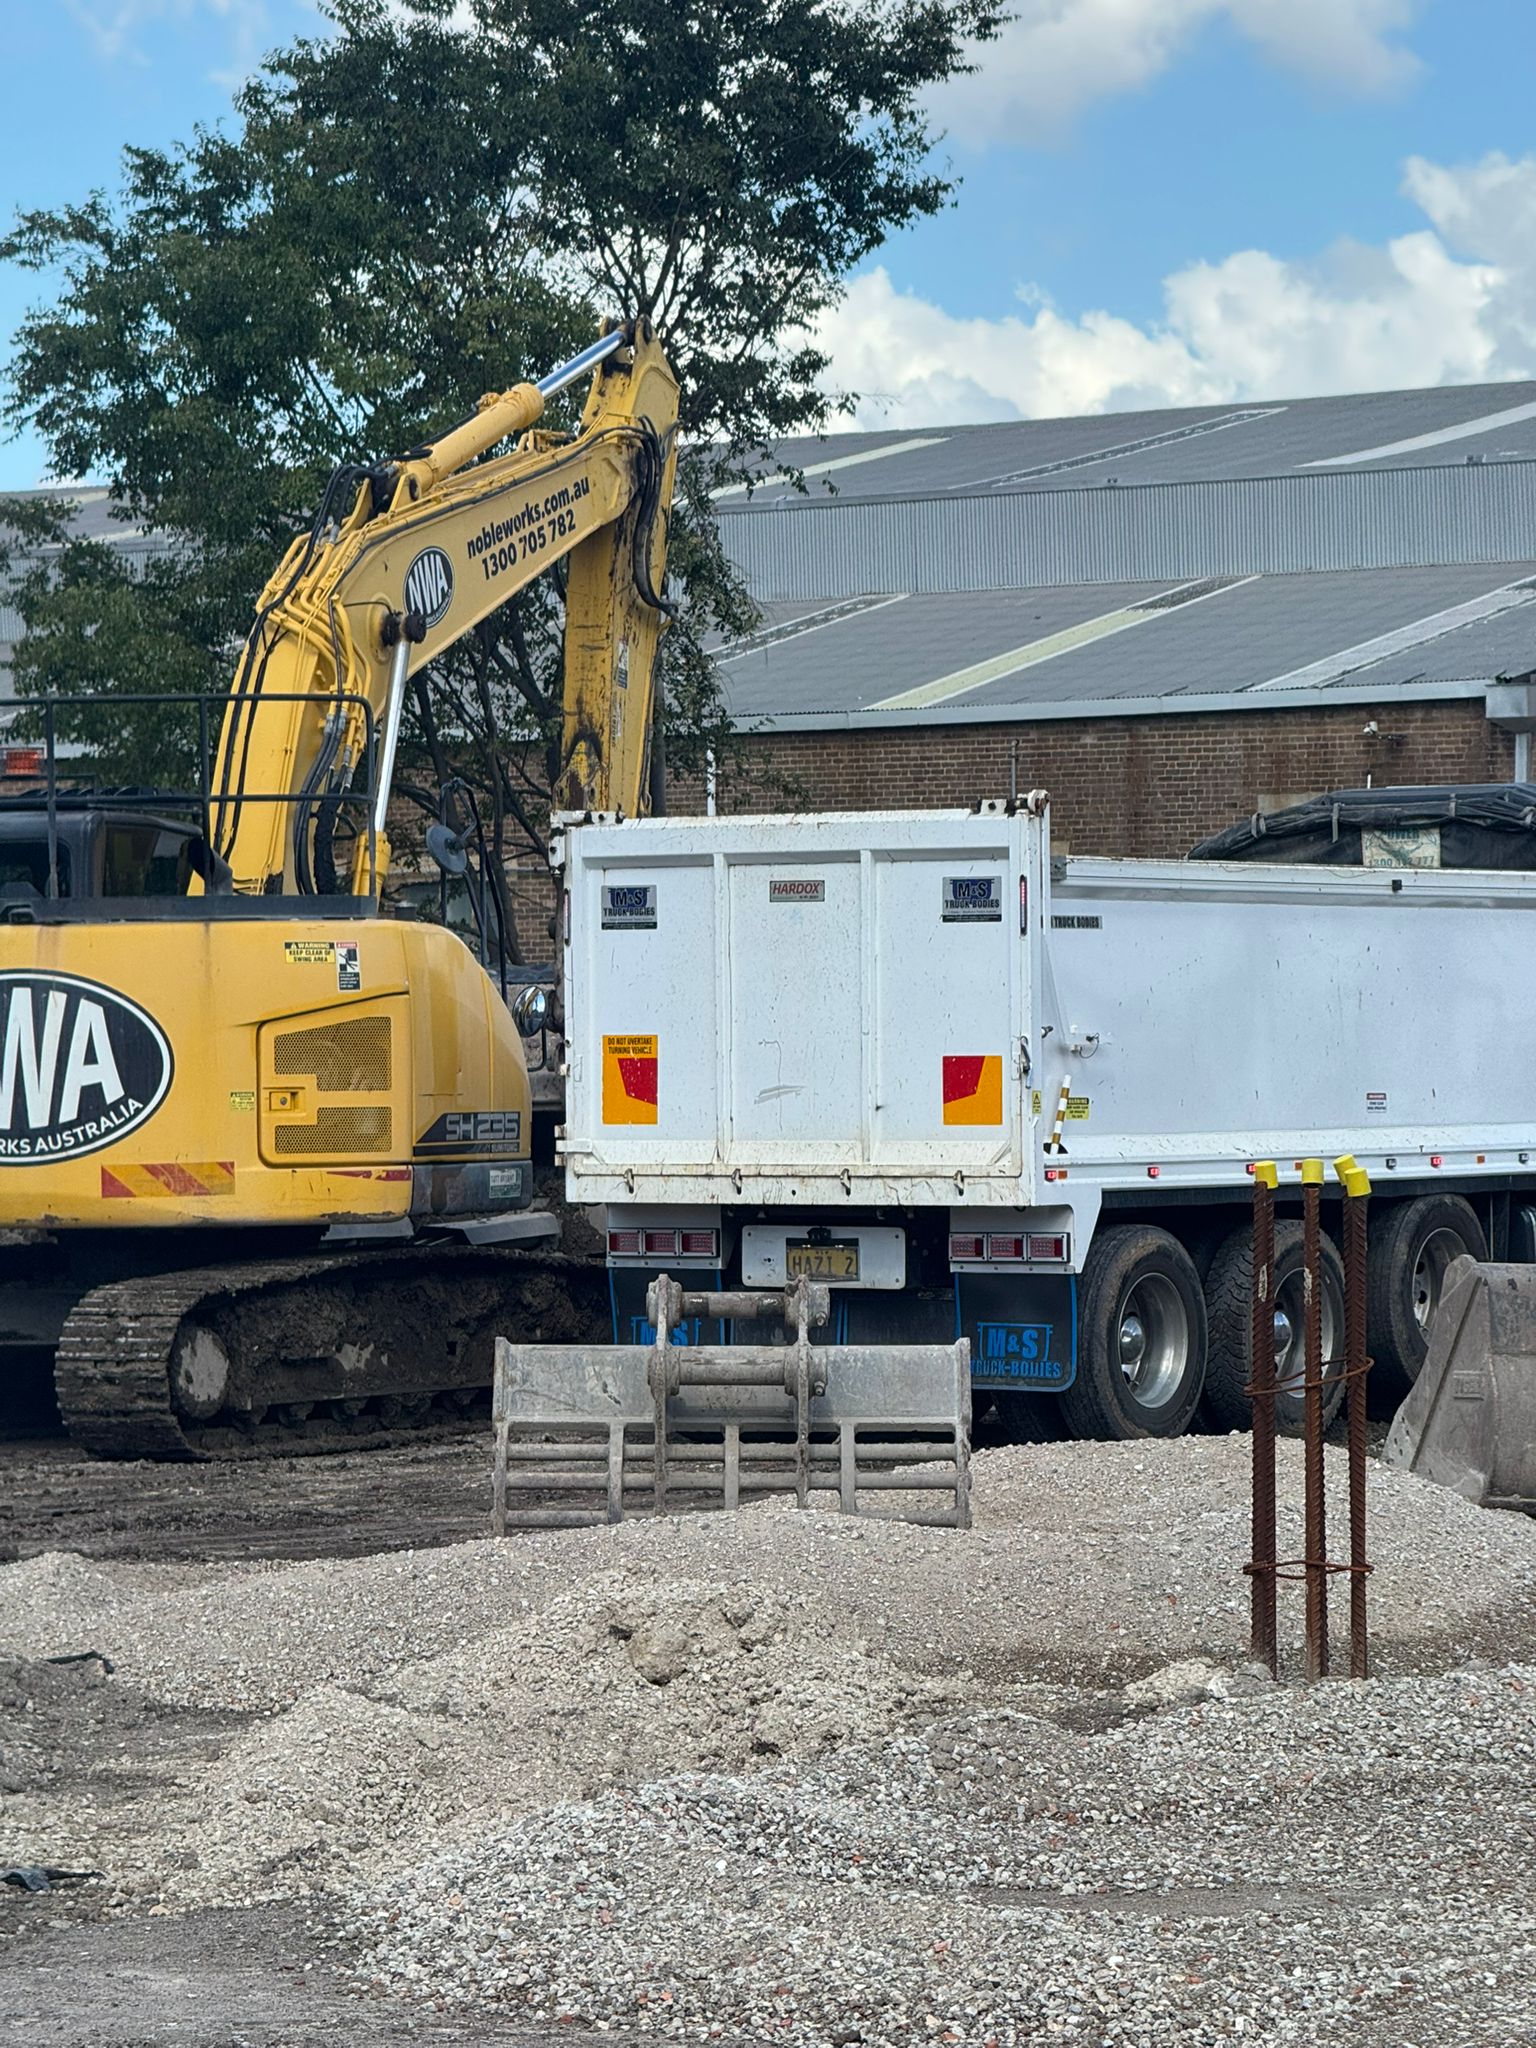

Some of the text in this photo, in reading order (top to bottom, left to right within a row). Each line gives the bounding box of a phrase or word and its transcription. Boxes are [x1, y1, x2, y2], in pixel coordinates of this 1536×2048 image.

[467, 476, 590, 559] nobleworks.com.au
[482, 509, 576, 580] 1300 705 782
[408, 553, 449, 615] NWA
[772, 883, 820, 895] HARDOX
[957, 882, 987, 898] M&S
[1054, 915, 1100, 929] TRUCK BODIES
[608, 1037, 653, 1045] DO NOT OVERTAKE
[608, 1046, 653, 1055] TURNING VEHICLE
[35, 1098, 143, 1154] AUSTRALIA
[987, 1328, 1039, 1359] M&S
